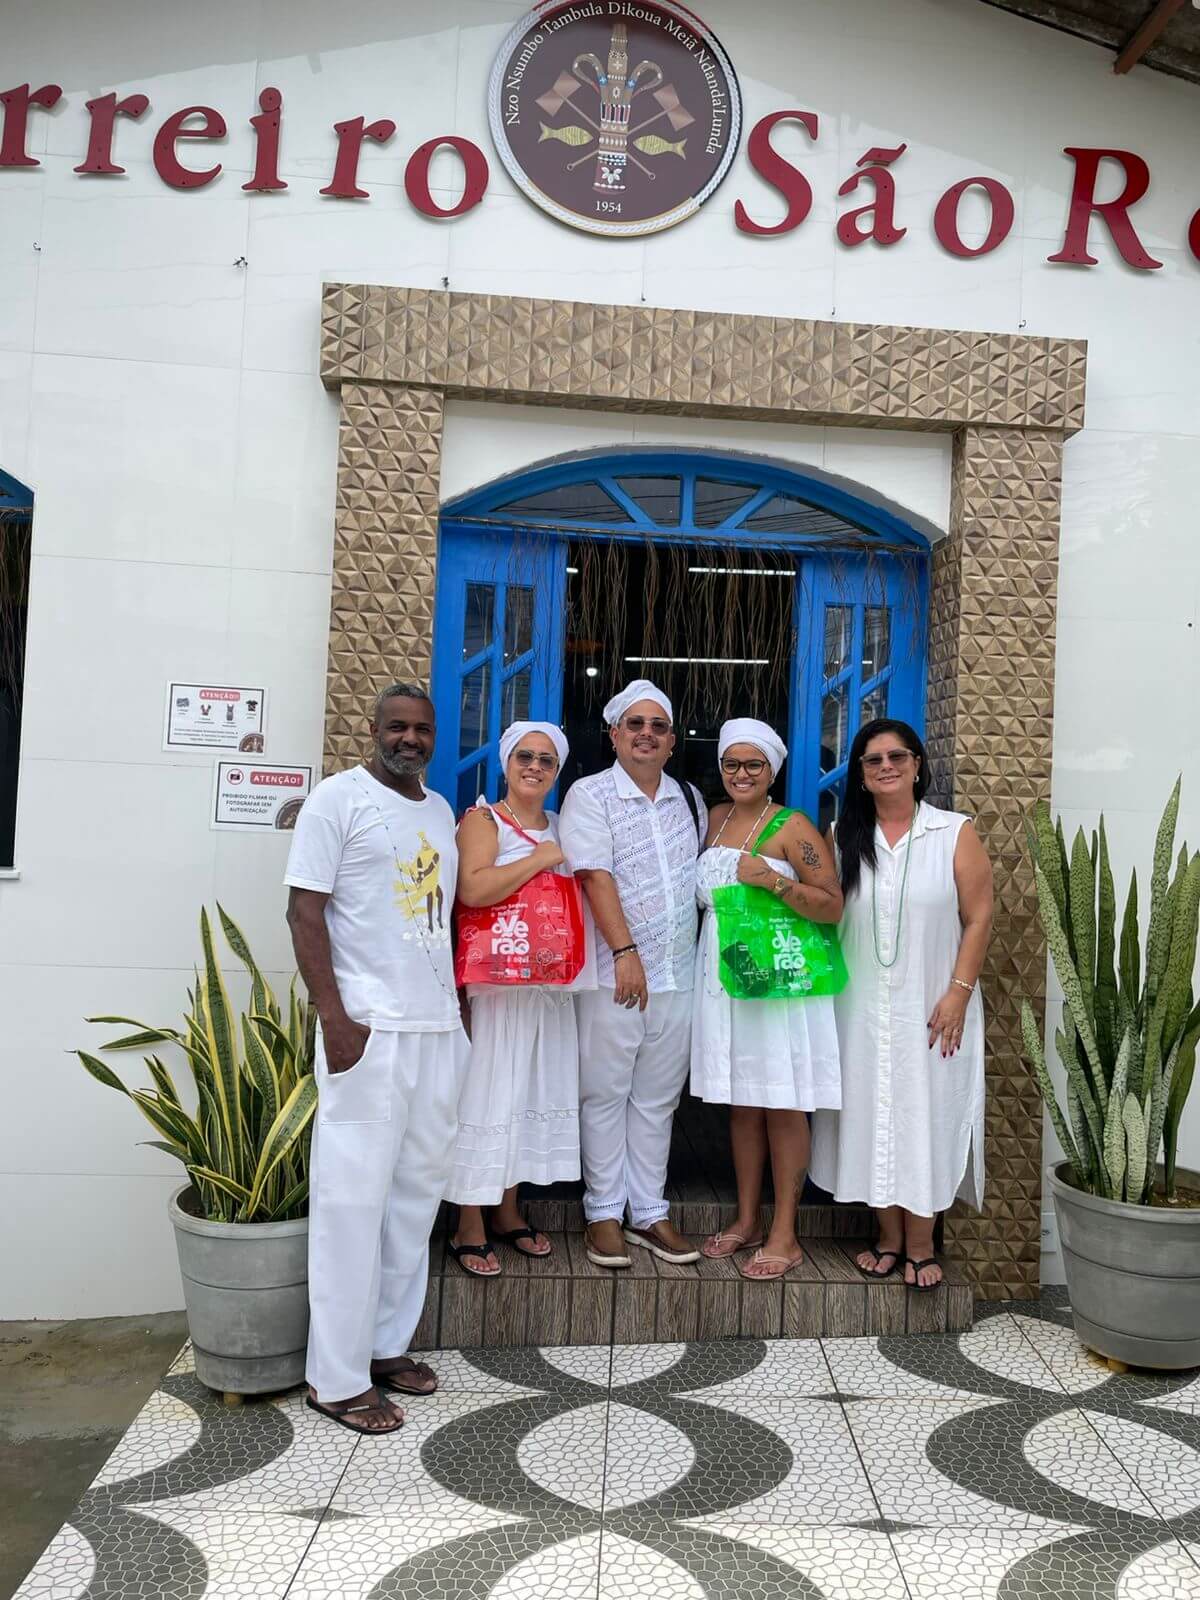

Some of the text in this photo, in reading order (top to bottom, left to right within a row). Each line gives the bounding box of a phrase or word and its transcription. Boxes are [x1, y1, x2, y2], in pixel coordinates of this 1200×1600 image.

[541, 5, 604, 36] Tambula
[608, 1, 662, 26] Dikoua
[507, 35, 544, 91] Nsumbo
[505, 94, 521, 126] Nzo
[595, 200, 622, 214] 1954
[733, 110, 1015, 258] São
[1046, 147, 1200, 274] R
[253, 773, 301, 786] ATENÇÃO!
